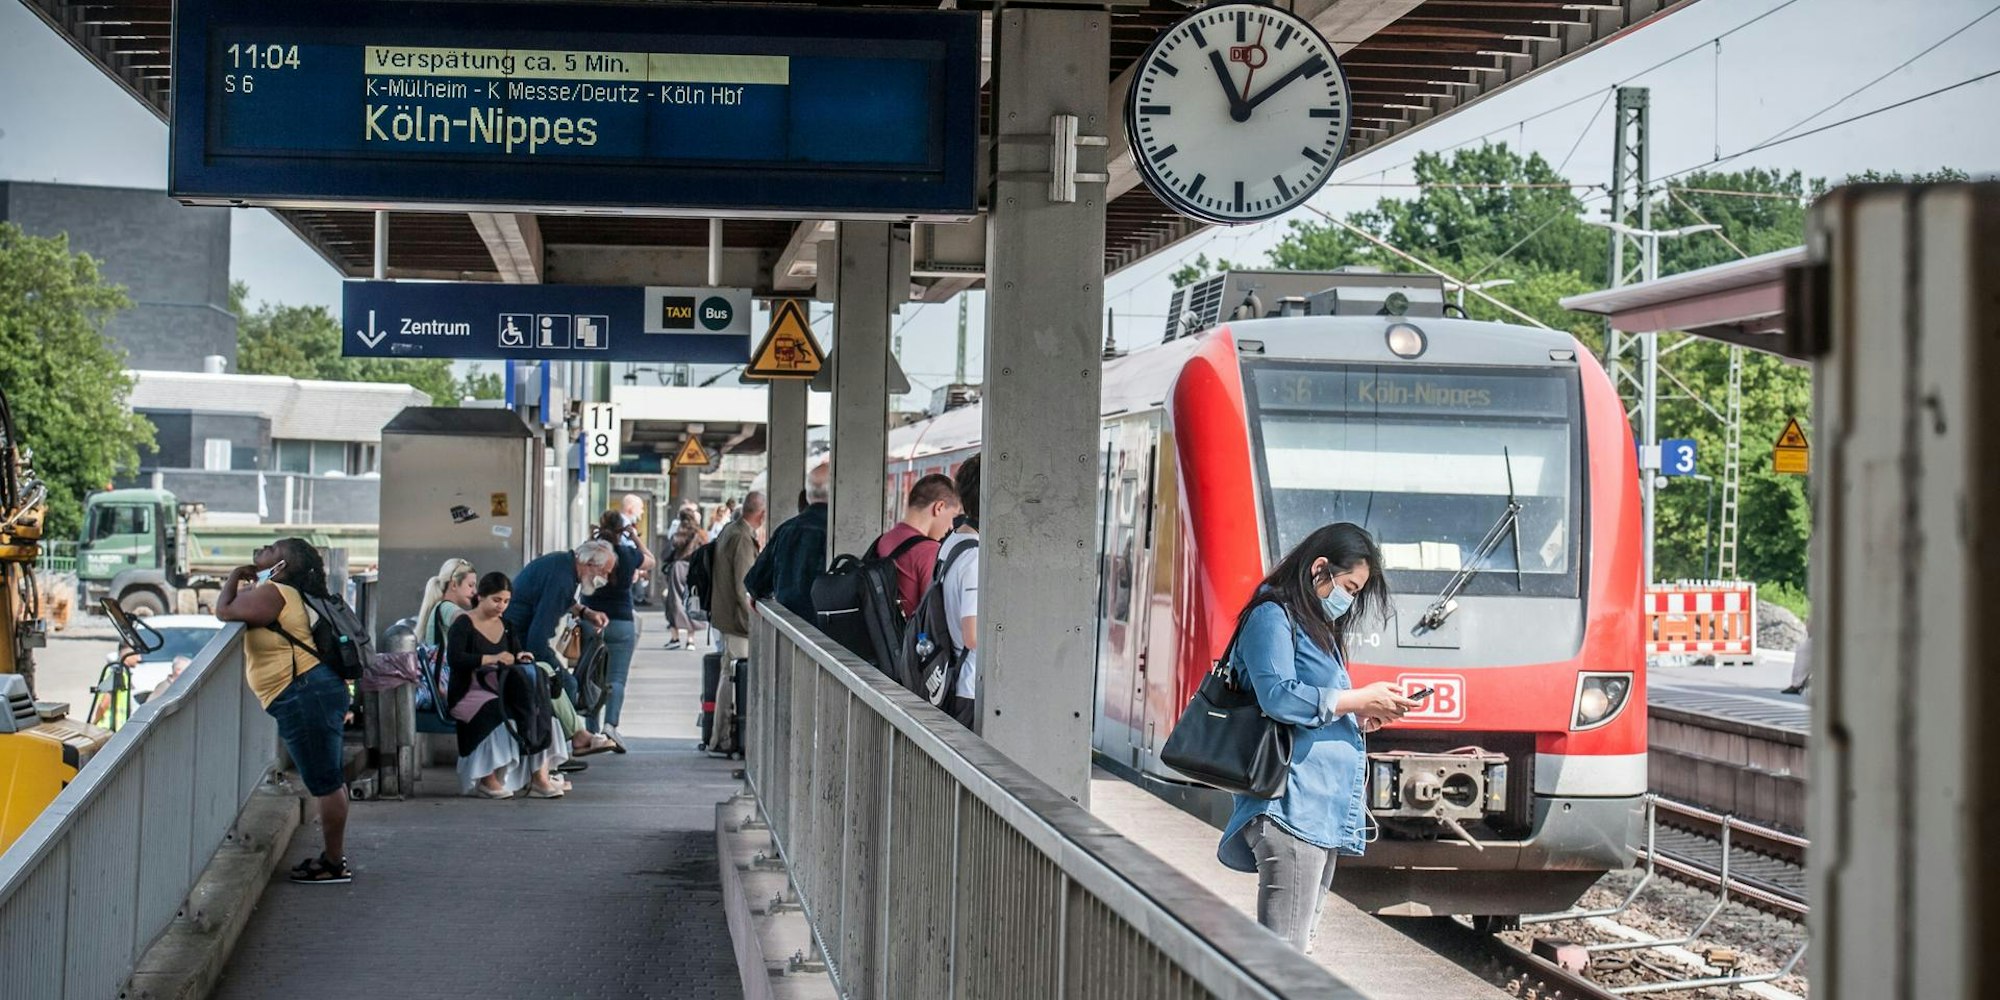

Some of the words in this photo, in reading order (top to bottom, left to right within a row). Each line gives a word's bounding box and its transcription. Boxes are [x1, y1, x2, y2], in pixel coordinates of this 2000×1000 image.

[227, 43, 301, 70] 11:04
[375, 48, 515, 75] Verspätung
[524, 56, 557, 72] ca.
[565, 54, 577, 72] 5
[585, 55, 630, 74] Min.
[225, 74, 236, 94] S
[242, 75, 253, 94] 6
[366, 78, 467, 99] K-Mülheim
[488, 82, 501, 99] K
[508, 81, 640, 103] Messe/Deutz
[661, 85, 705, 105] Köln
[711, 86, 744, 106] Hbf
[365, 104, 598, 155] Köln-Nippes
[666, 306, 692, 319] TAXI
[706, 307, 728, 320] Bus
[400, 318, 471, 336] Zentrum
[1358, 380, 1491, 407] Köln-Nippes
[591, 406, 613, 430] 11
[594, 433, 609, 457] 8
[1675, 445, 1694, 473] 3
[926, 665, 942, 694] NIKE
[1407, 682, 1456, 713] DB
